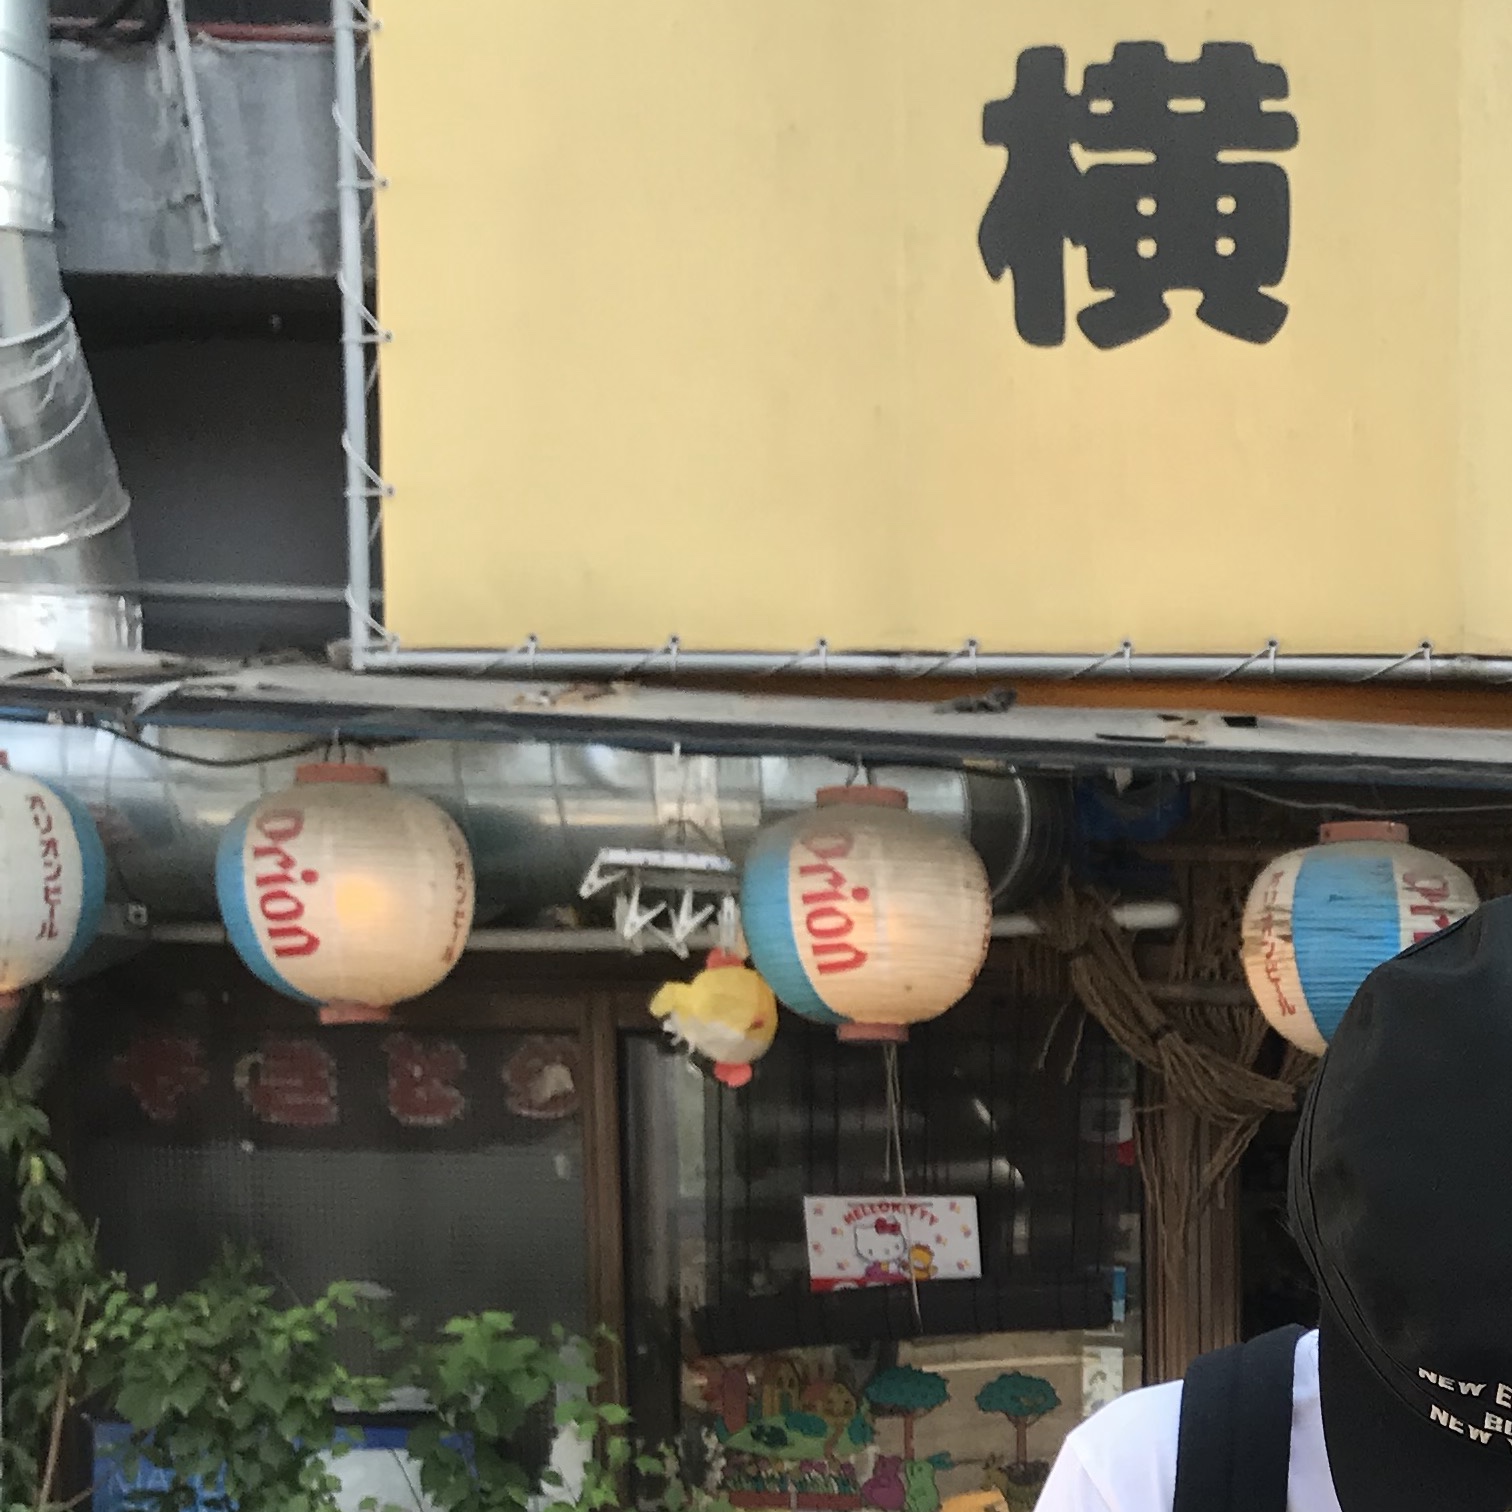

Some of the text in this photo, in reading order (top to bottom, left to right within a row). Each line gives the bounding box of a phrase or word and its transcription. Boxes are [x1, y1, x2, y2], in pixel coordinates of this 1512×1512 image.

[844, 1202, 890, 1225] HELLO
[1418, 1367, 1487, 1397] NEW
[1429, 1404, 1493, 1444] NEW
